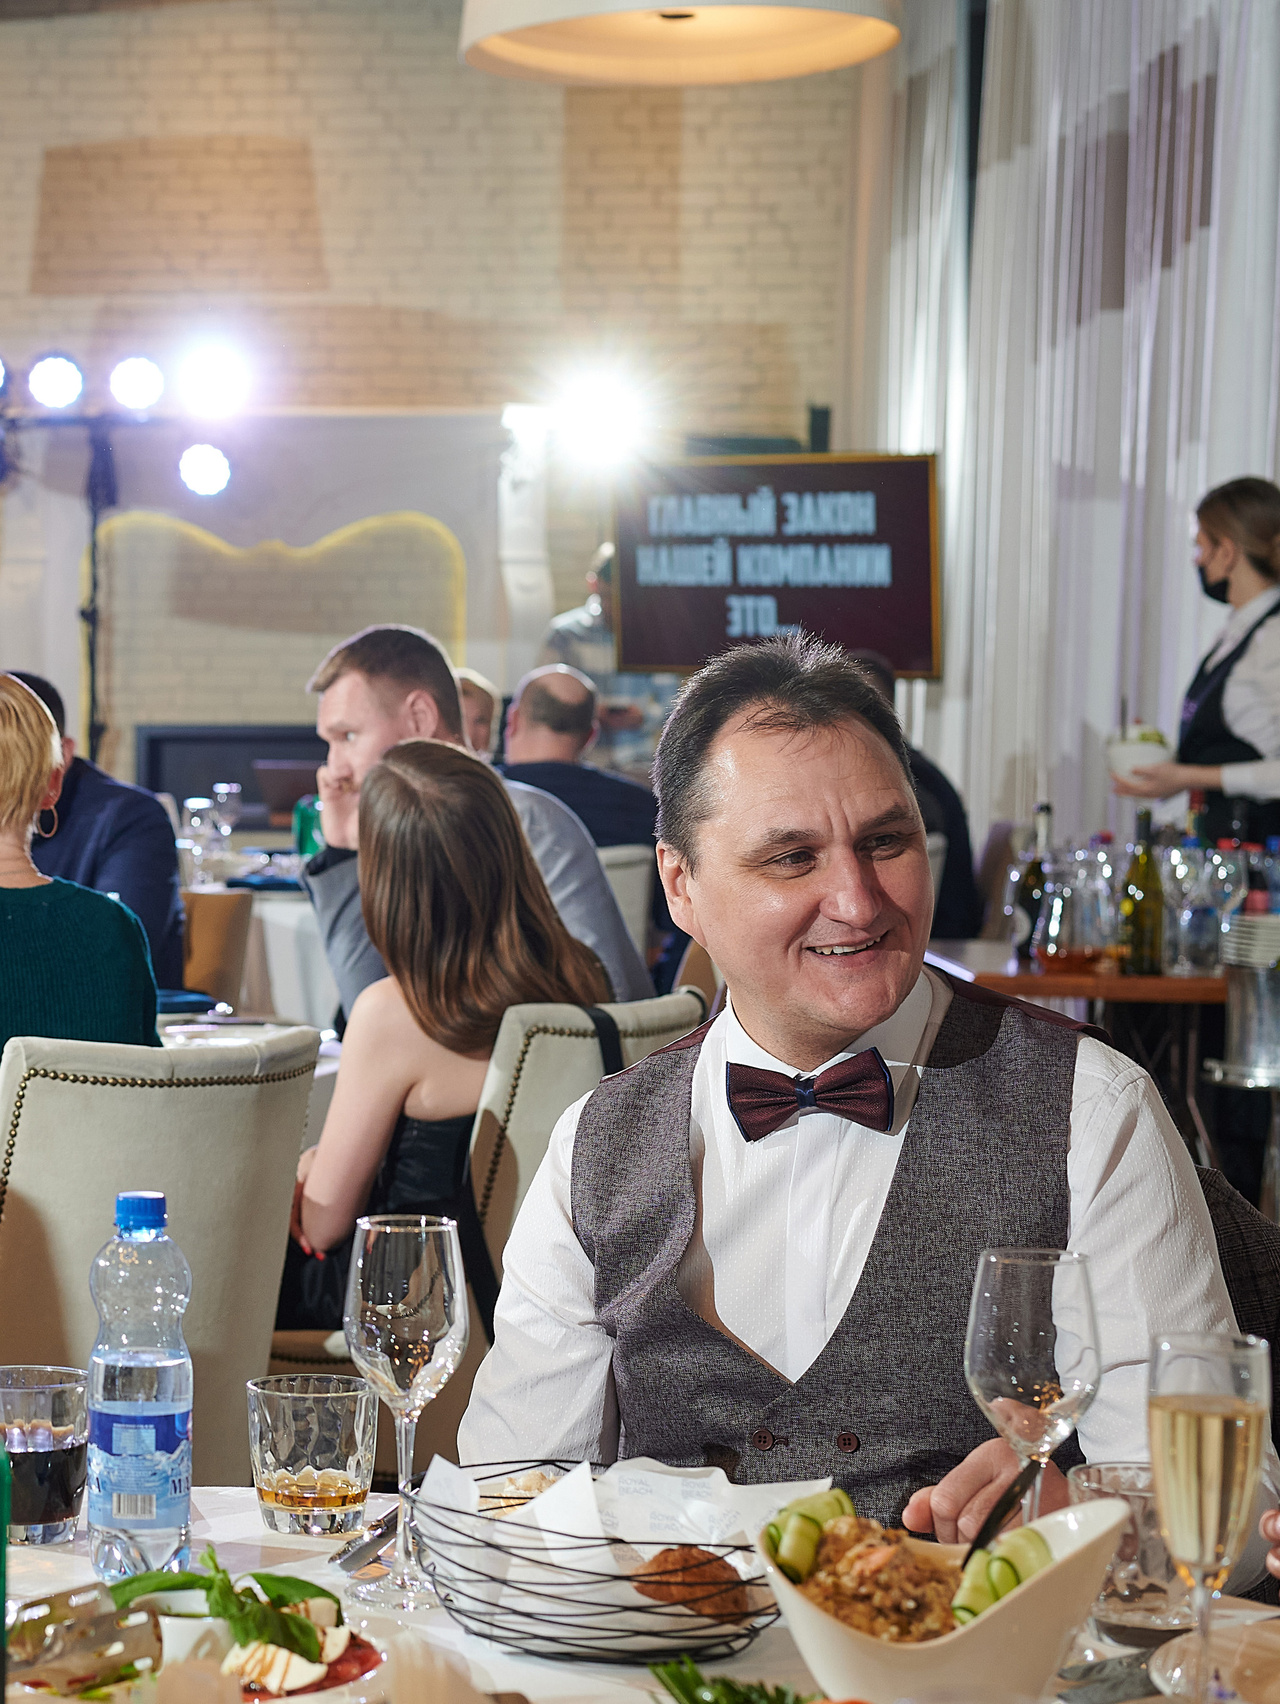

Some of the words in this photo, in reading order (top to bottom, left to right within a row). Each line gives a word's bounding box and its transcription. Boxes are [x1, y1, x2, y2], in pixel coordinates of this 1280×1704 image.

[648, 484, 777, 537] ГЛАВНЫЙ
[781, 491, 877, 536] ЗАКОН
[635, 537, 733, 587] НАШЕЙ
[737, 543, 893, 588] КОМПАНИИ
[619, 1475, 650, 1487] ROYAL
[619, 1486, 653, 1496] BEACH
